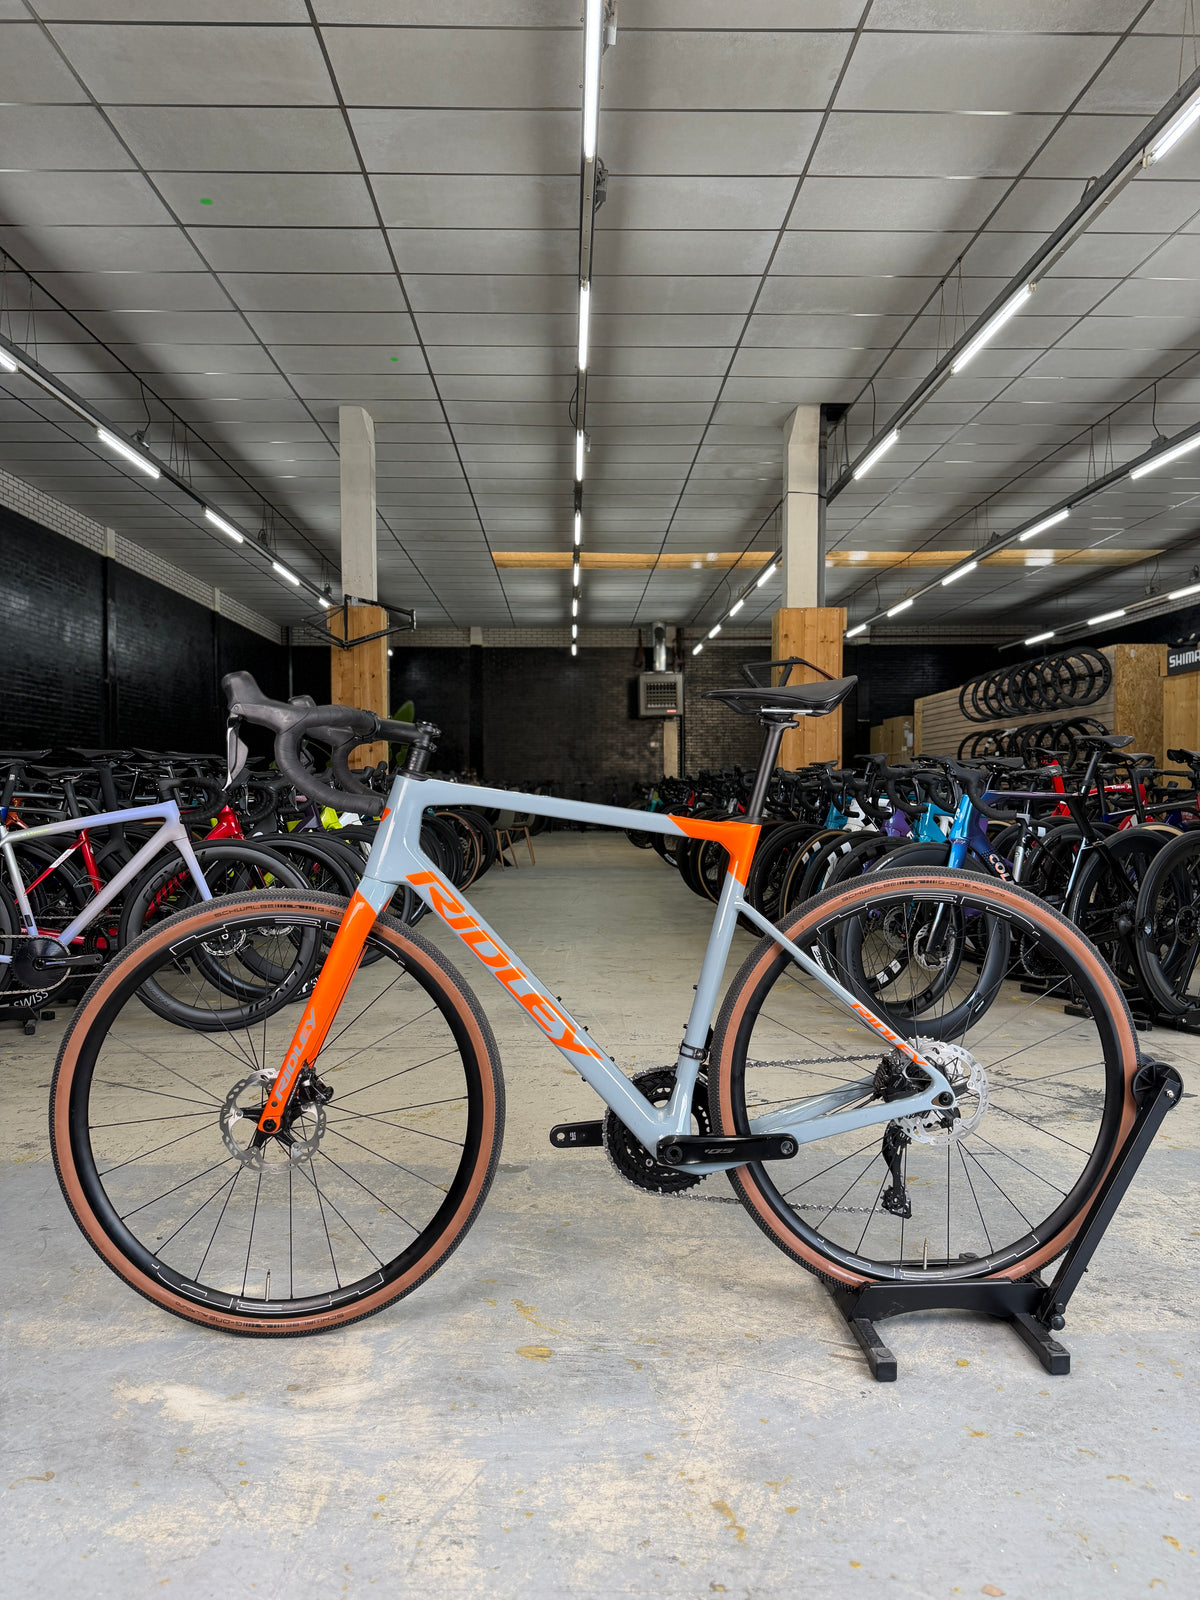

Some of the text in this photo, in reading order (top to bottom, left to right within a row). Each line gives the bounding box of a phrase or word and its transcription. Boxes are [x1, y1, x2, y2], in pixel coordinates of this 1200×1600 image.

[213, 903, 345, 918] SCHWALBE G-ON
[406, 870, 604, 1061] RIDLEY
[274, 1007, 316, 1102] RIDLEY
[850, 1002, 929, 1067] RIDLEY
